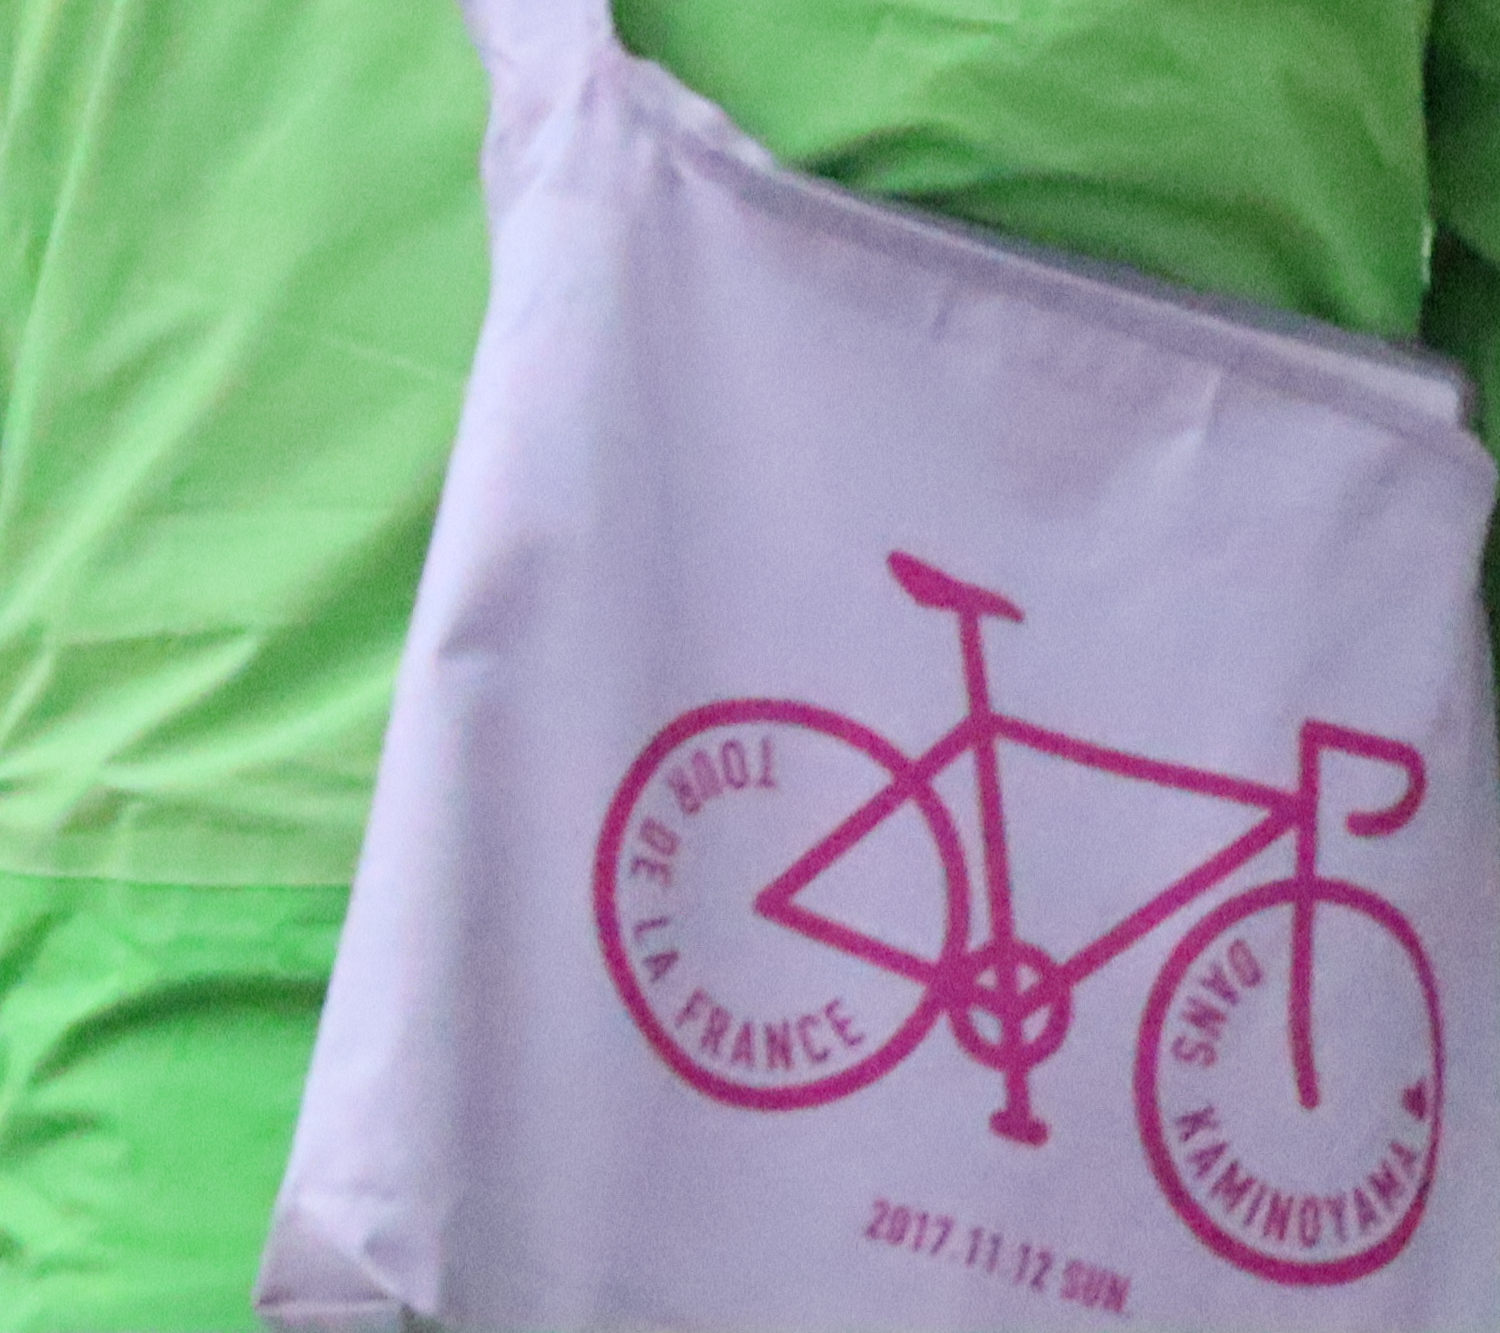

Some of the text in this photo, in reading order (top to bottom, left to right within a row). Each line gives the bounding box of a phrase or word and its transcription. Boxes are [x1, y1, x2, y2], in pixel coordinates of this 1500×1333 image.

[630, 737, 866, 1072] TOUR DE LA FRANCE
[865, 1197, 1054, 1293] 2017.11.12
[1170, 938, 1418, 1249] DANS KAMINOYAMA
